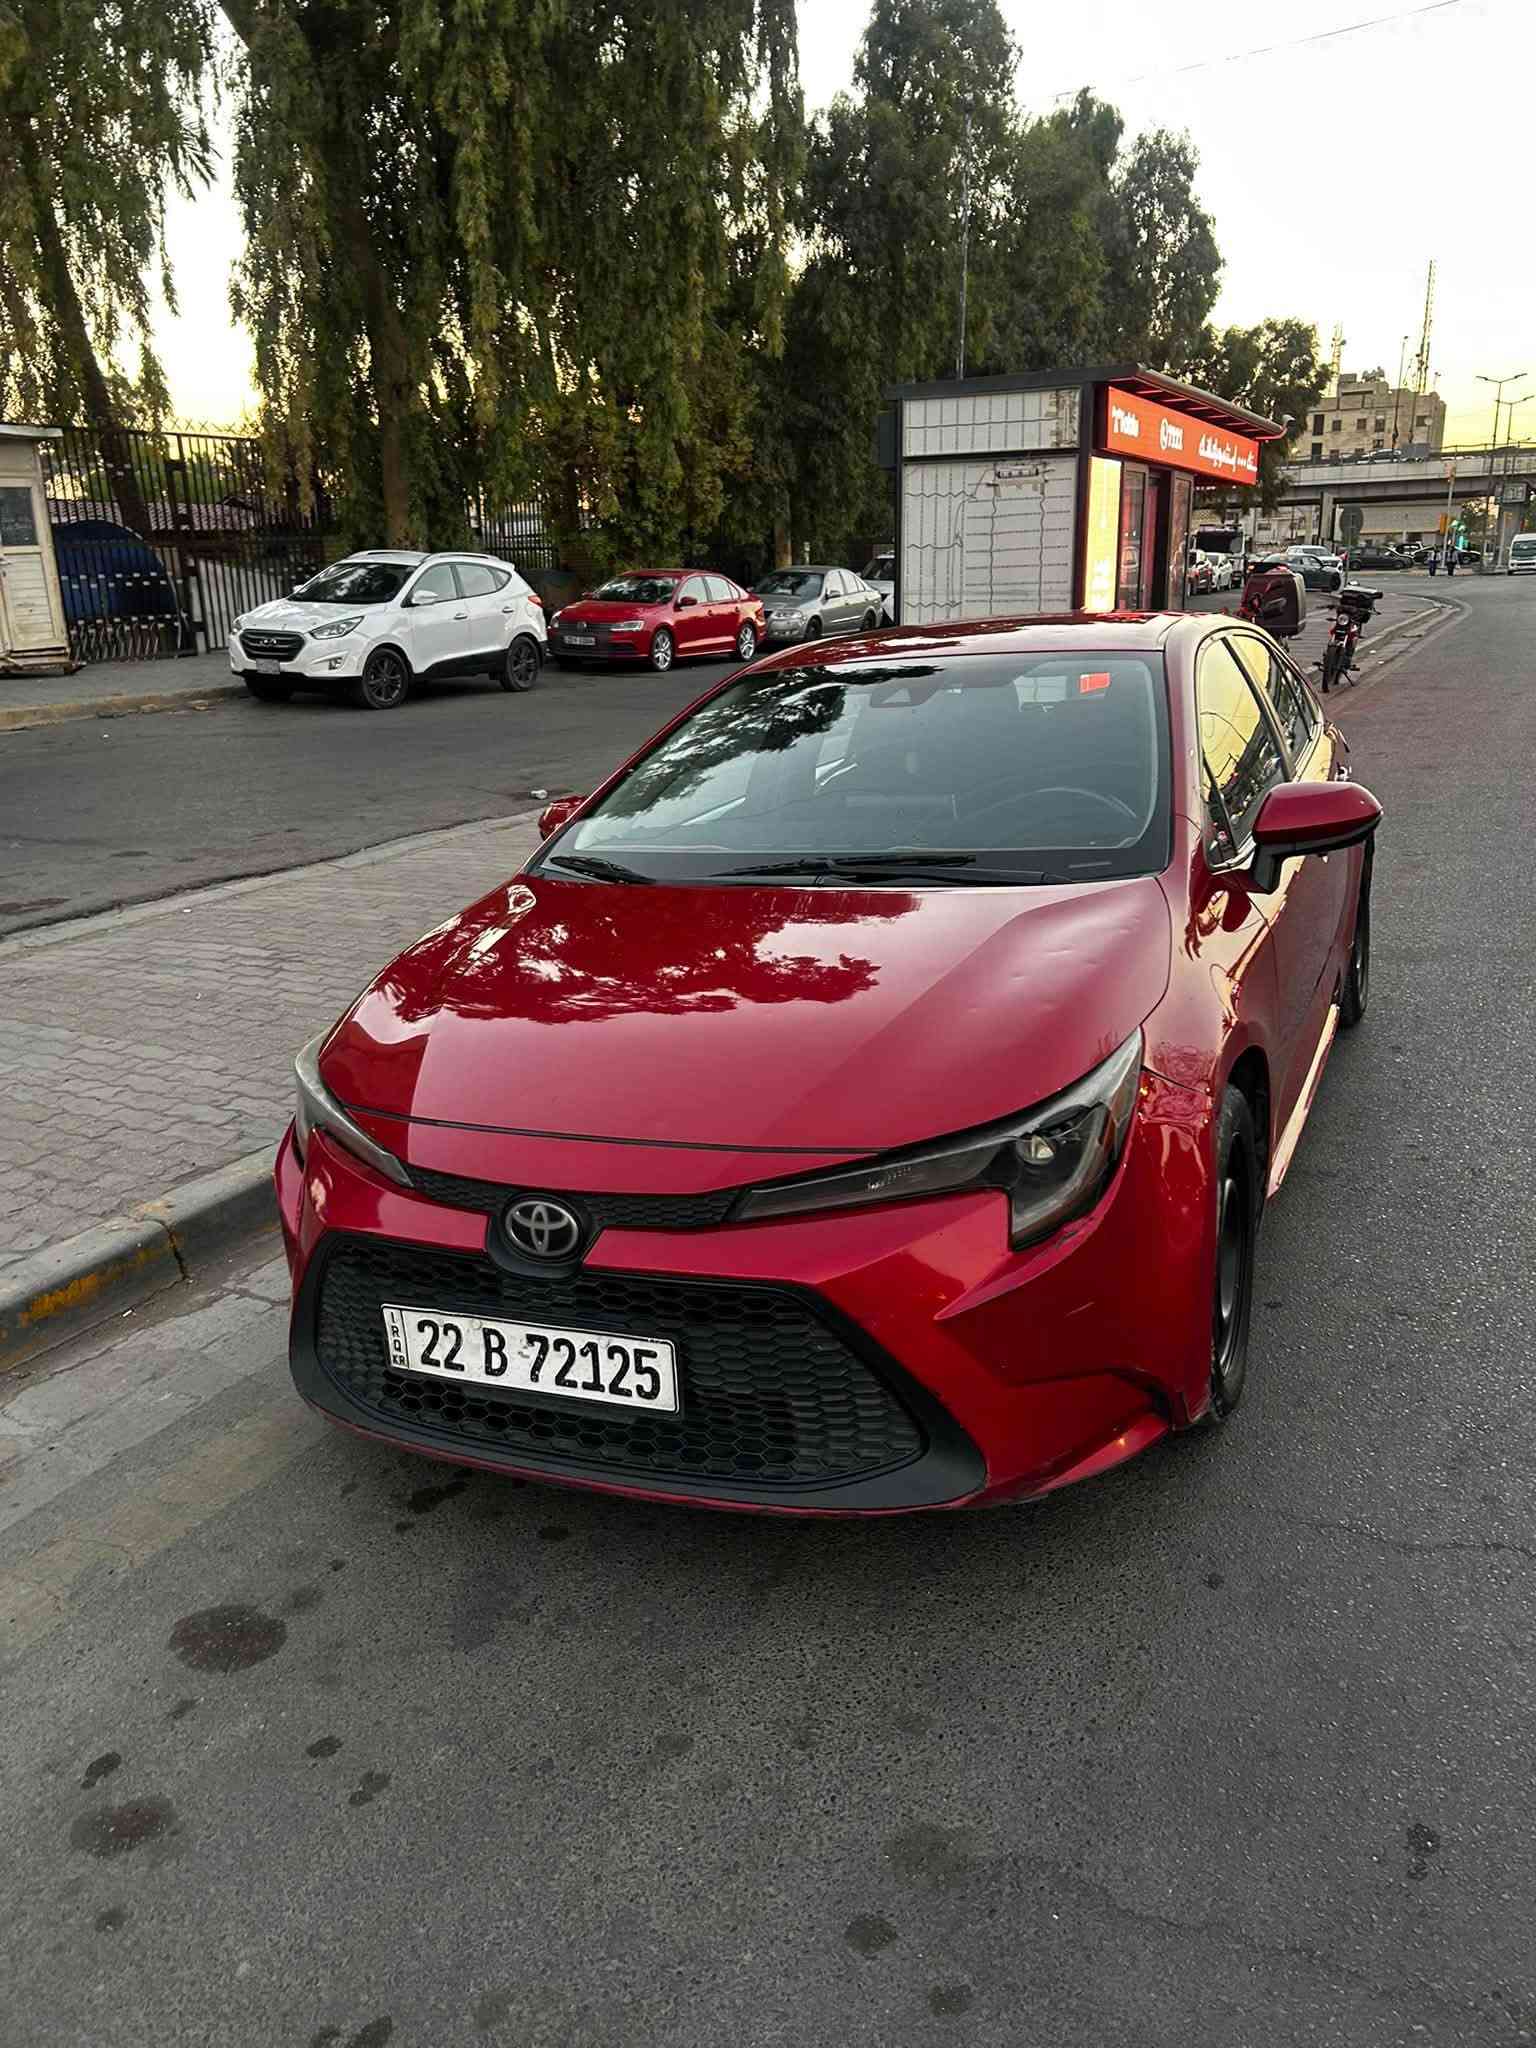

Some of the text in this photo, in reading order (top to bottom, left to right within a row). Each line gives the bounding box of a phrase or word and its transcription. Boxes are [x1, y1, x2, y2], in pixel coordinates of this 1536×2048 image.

[417, 1319, 662, 1400] 22 B 72125
